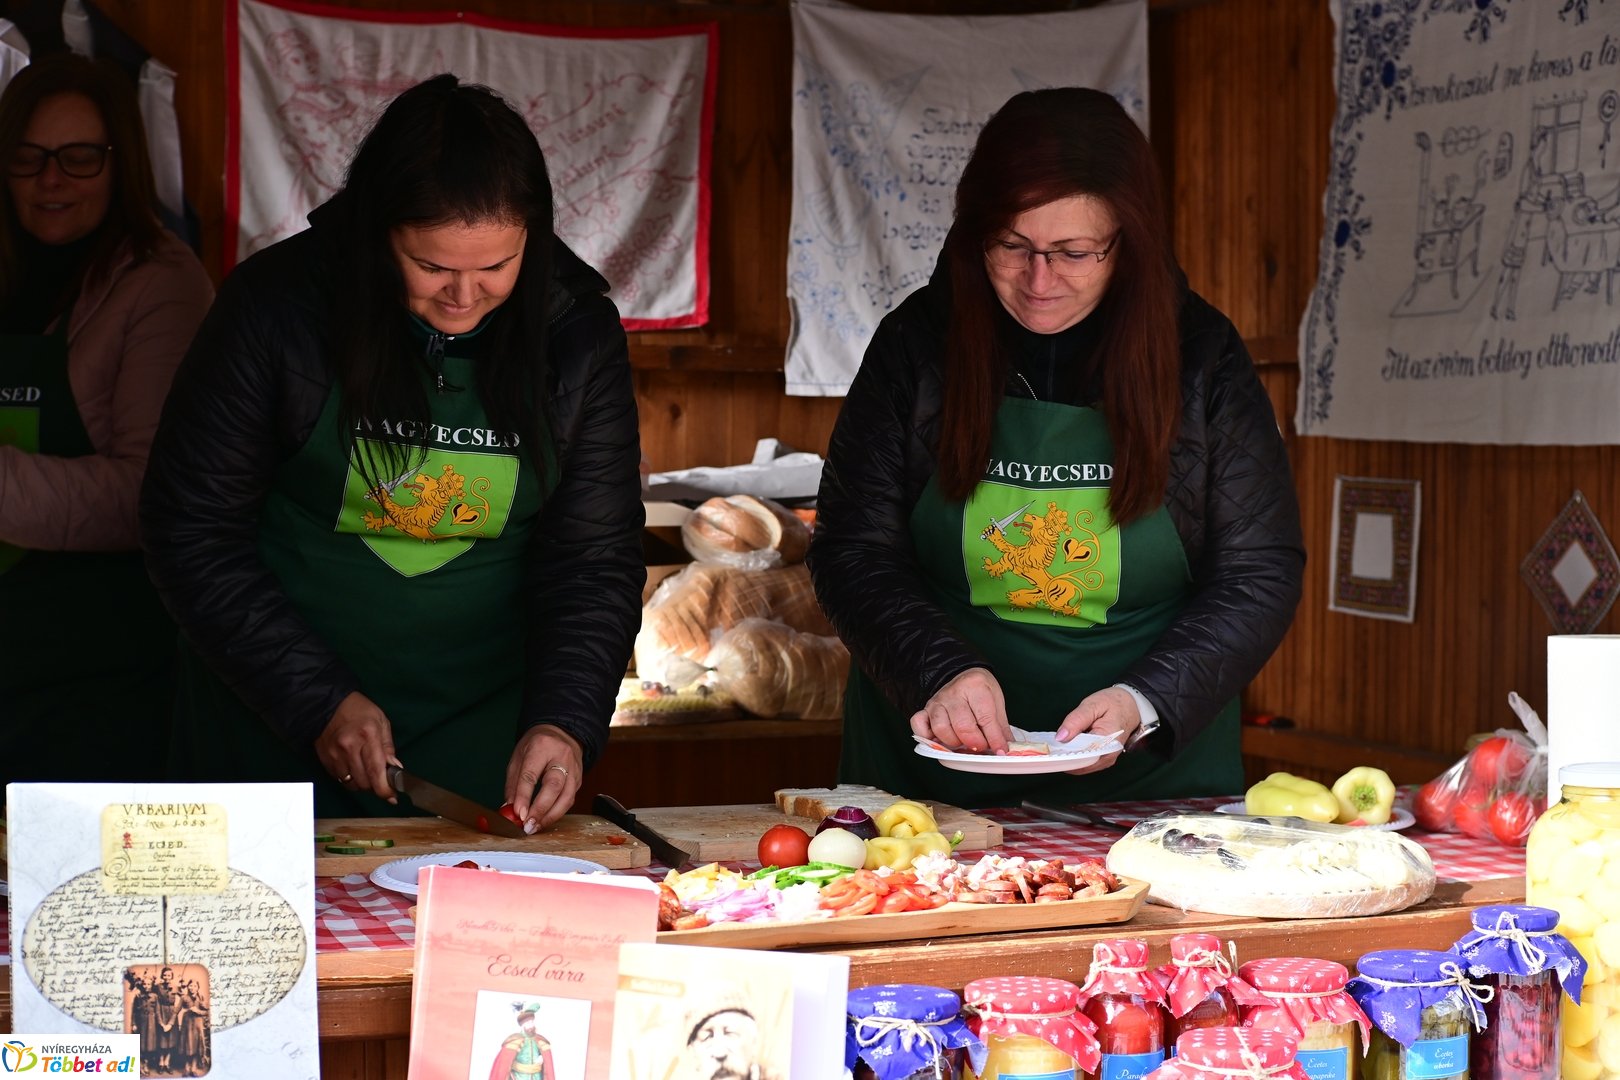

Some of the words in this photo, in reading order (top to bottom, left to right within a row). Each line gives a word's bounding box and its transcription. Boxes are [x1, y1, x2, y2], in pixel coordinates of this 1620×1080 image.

[0, 386, 41, 402] SED
[986, 458, 1113, 483] AGYECSED
[487, 953, 563, 978] Ecsed
[544, 961, 585, 983] vára
